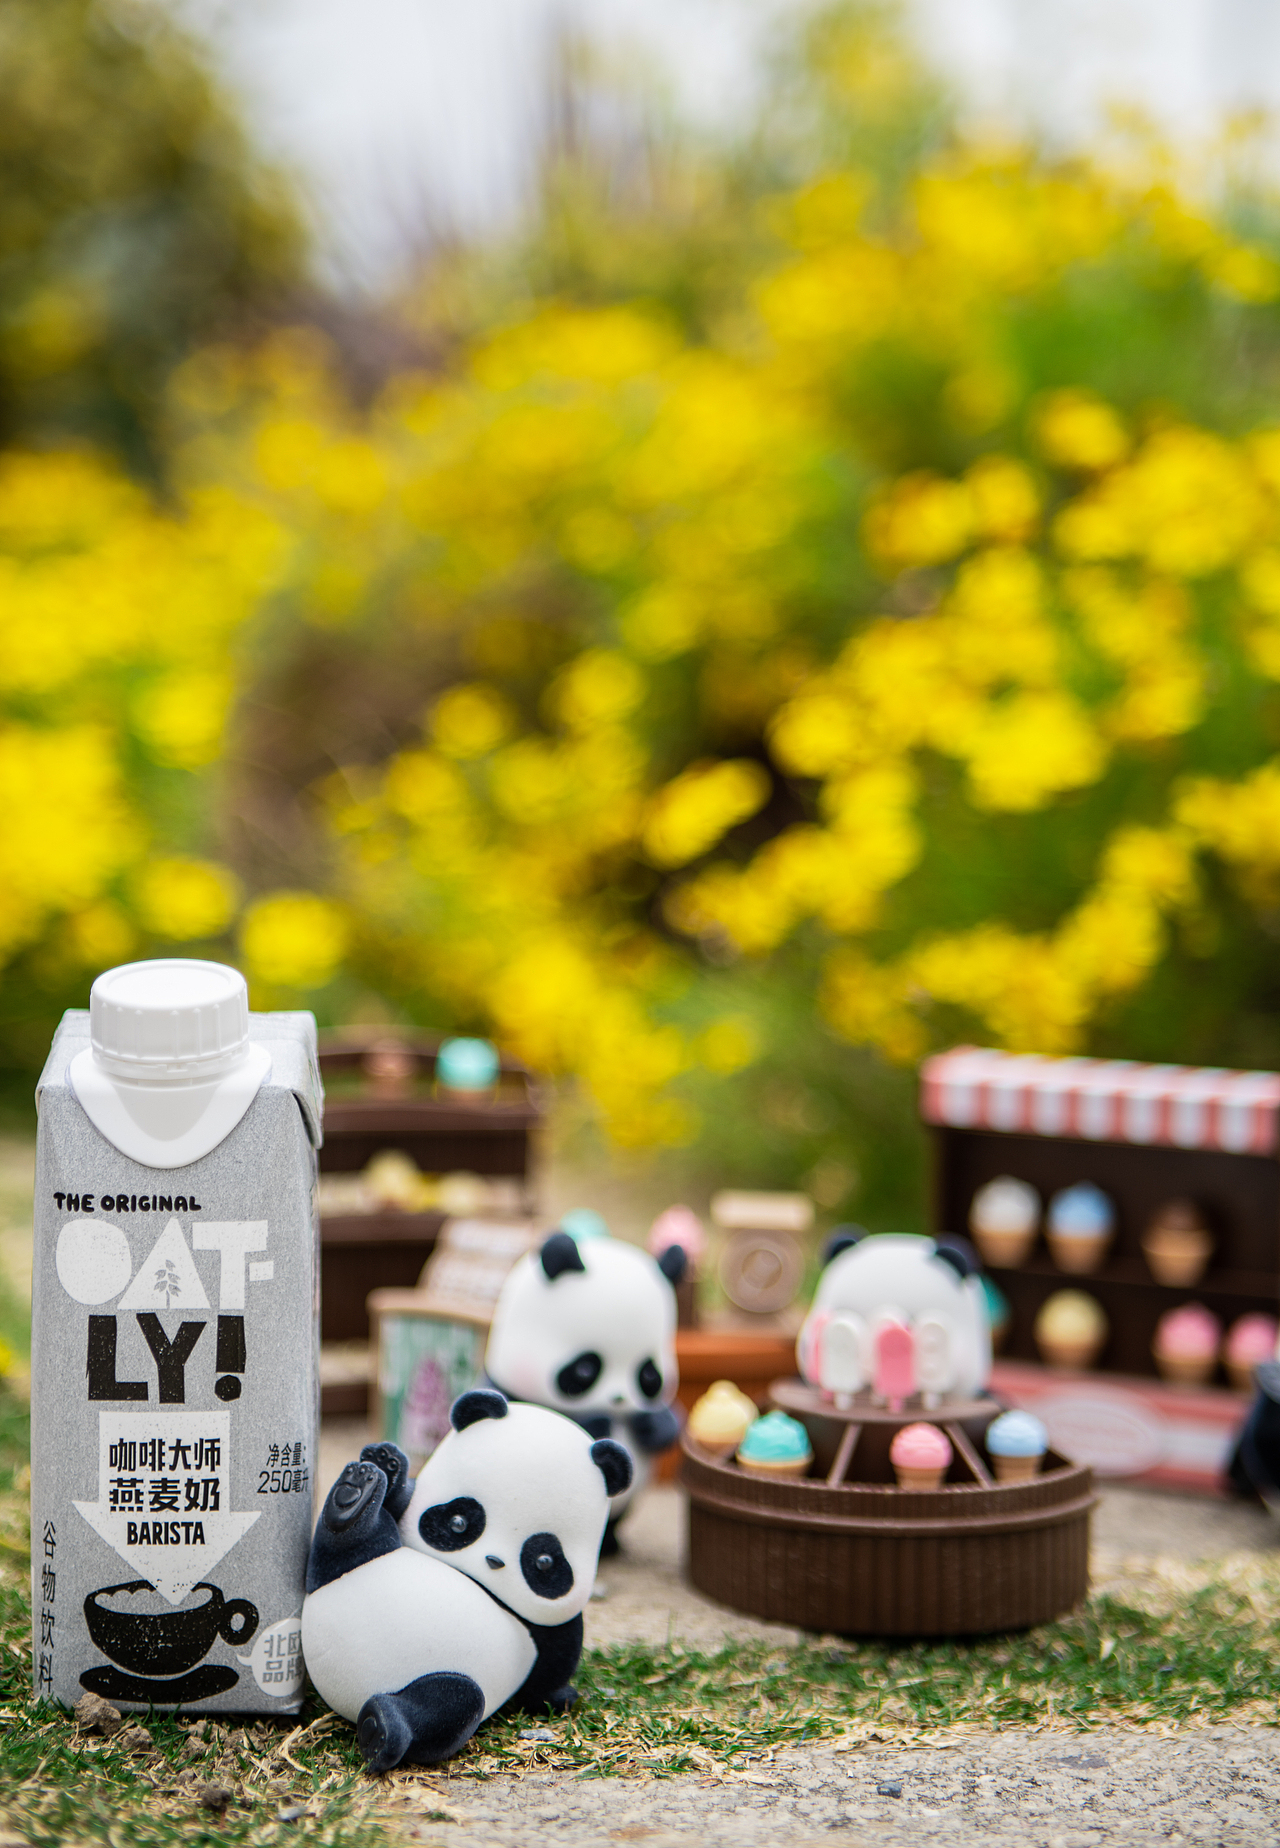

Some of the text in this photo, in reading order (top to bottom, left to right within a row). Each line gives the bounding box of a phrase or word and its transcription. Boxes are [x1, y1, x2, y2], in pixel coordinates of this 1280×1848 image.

[53, 1192, 202, 1213] THE ORIGINAL
[86, 1312, 246, 1404] LY!
[109, 1438, 221, 1472] 咖啡大师
[109, 1477, 220, 1512] 燕麦奶
[126, 1521, 205, 1545] BARISTA
[39, 1520, 56, 1693] 谷物饮料
